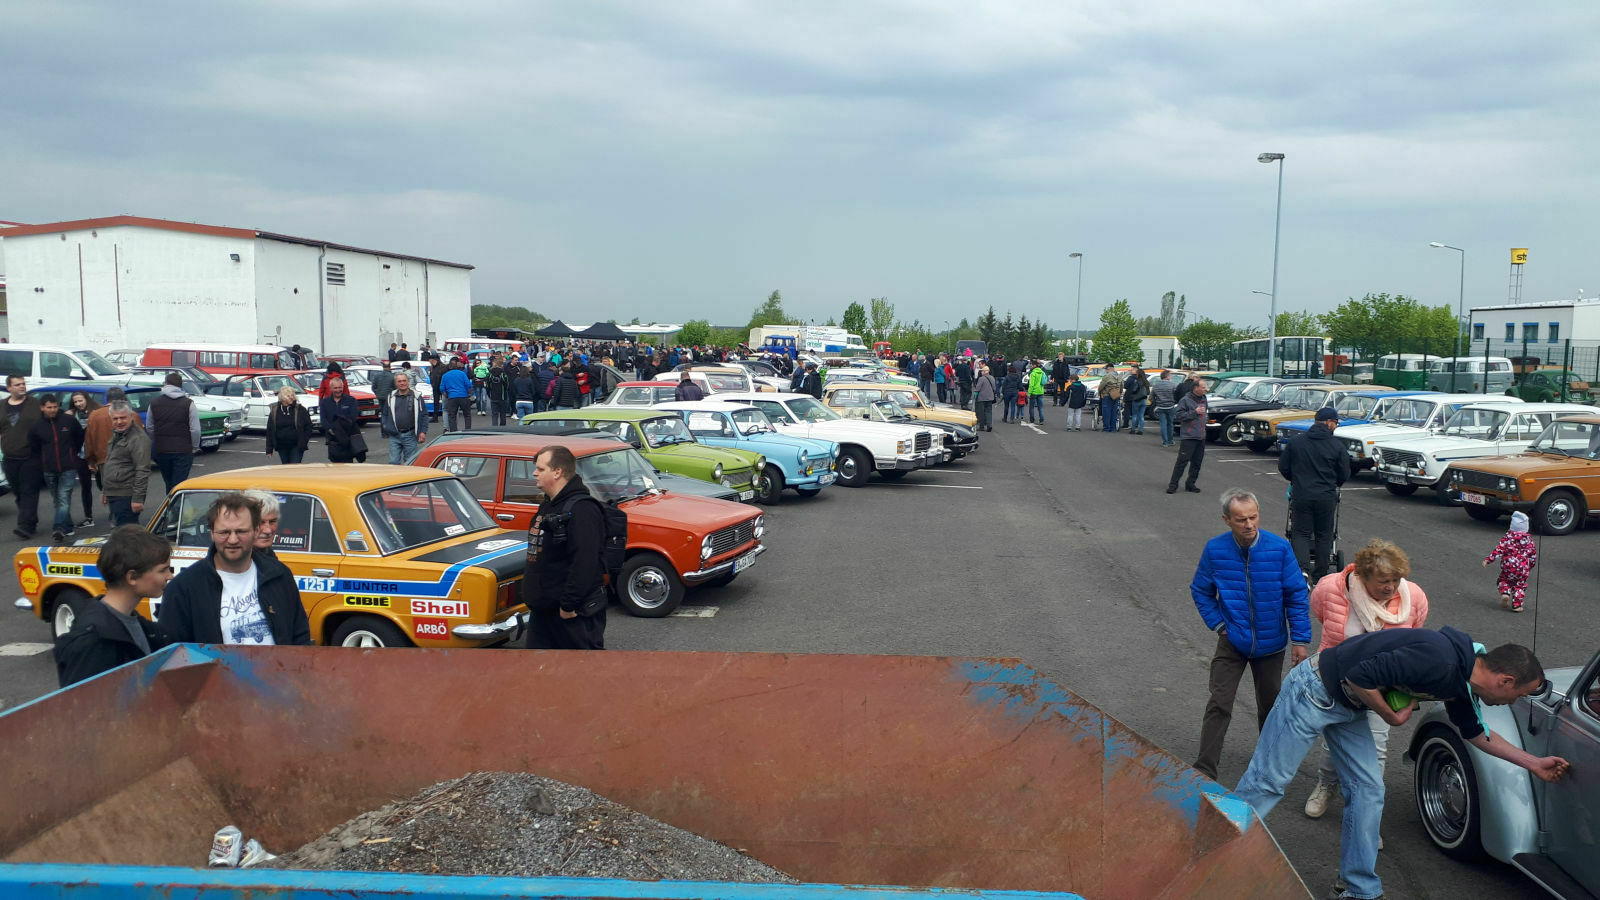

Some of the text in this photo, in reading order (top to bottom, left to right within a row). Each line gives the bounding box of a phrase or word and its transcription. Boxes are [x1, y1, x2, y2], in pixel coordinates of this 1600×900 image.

[303, 578, 325, 591] 125
[327, 580, 336, 592] P
[353, 582, 398, 593] UNITRA
[412, 601, 468, 615] Shell
[416, 622, 447, 635] ARBÖ
